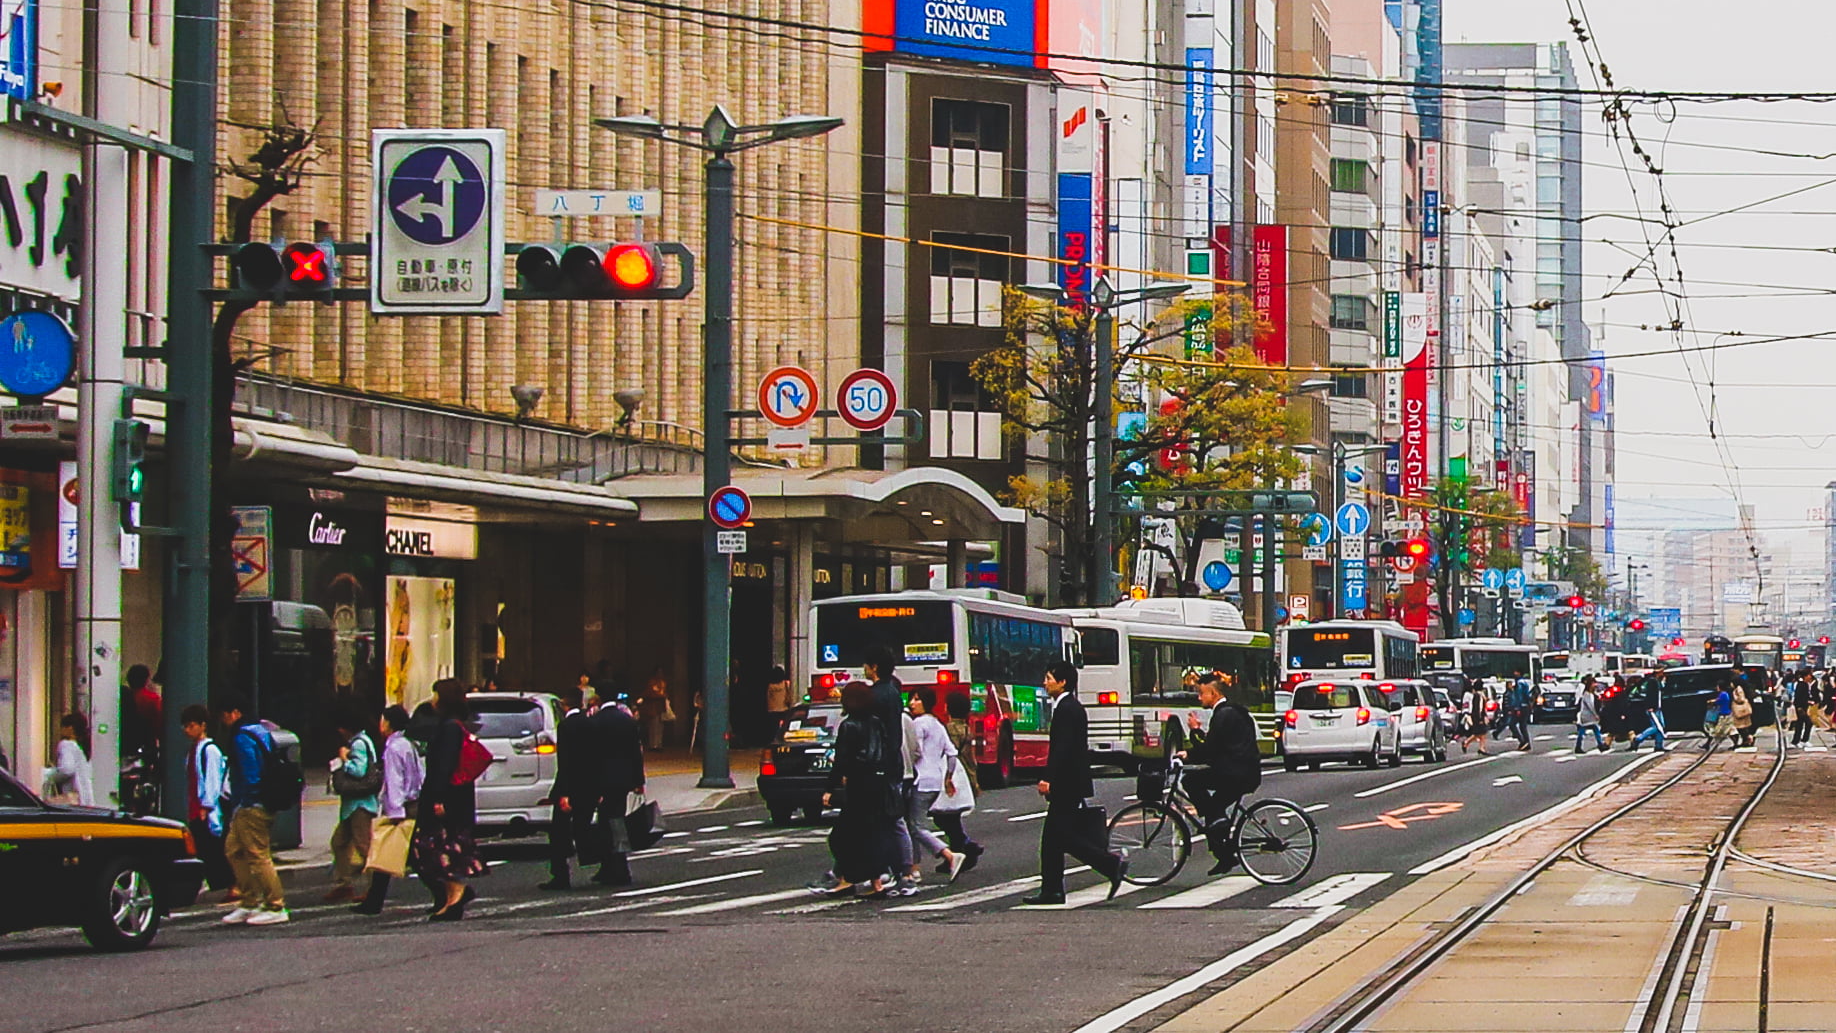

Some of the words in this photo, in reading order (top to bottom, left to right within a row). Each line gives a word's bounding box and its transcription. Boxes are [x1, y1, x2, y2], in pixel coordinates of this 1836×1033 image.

[925, 2, 1008, 27] CONSUMER
[925, 18, 990, 40] FINANCE
[552, 195, 645, 211] 八丁堀
[1064, 232, 1086, 314] PROMI
[851, 387, 883, 413] 50
[308, 512, 347, 545] Cartier
[386, 529, 435, 556] CHANEL
[1293, 597, 1306, 608] P
